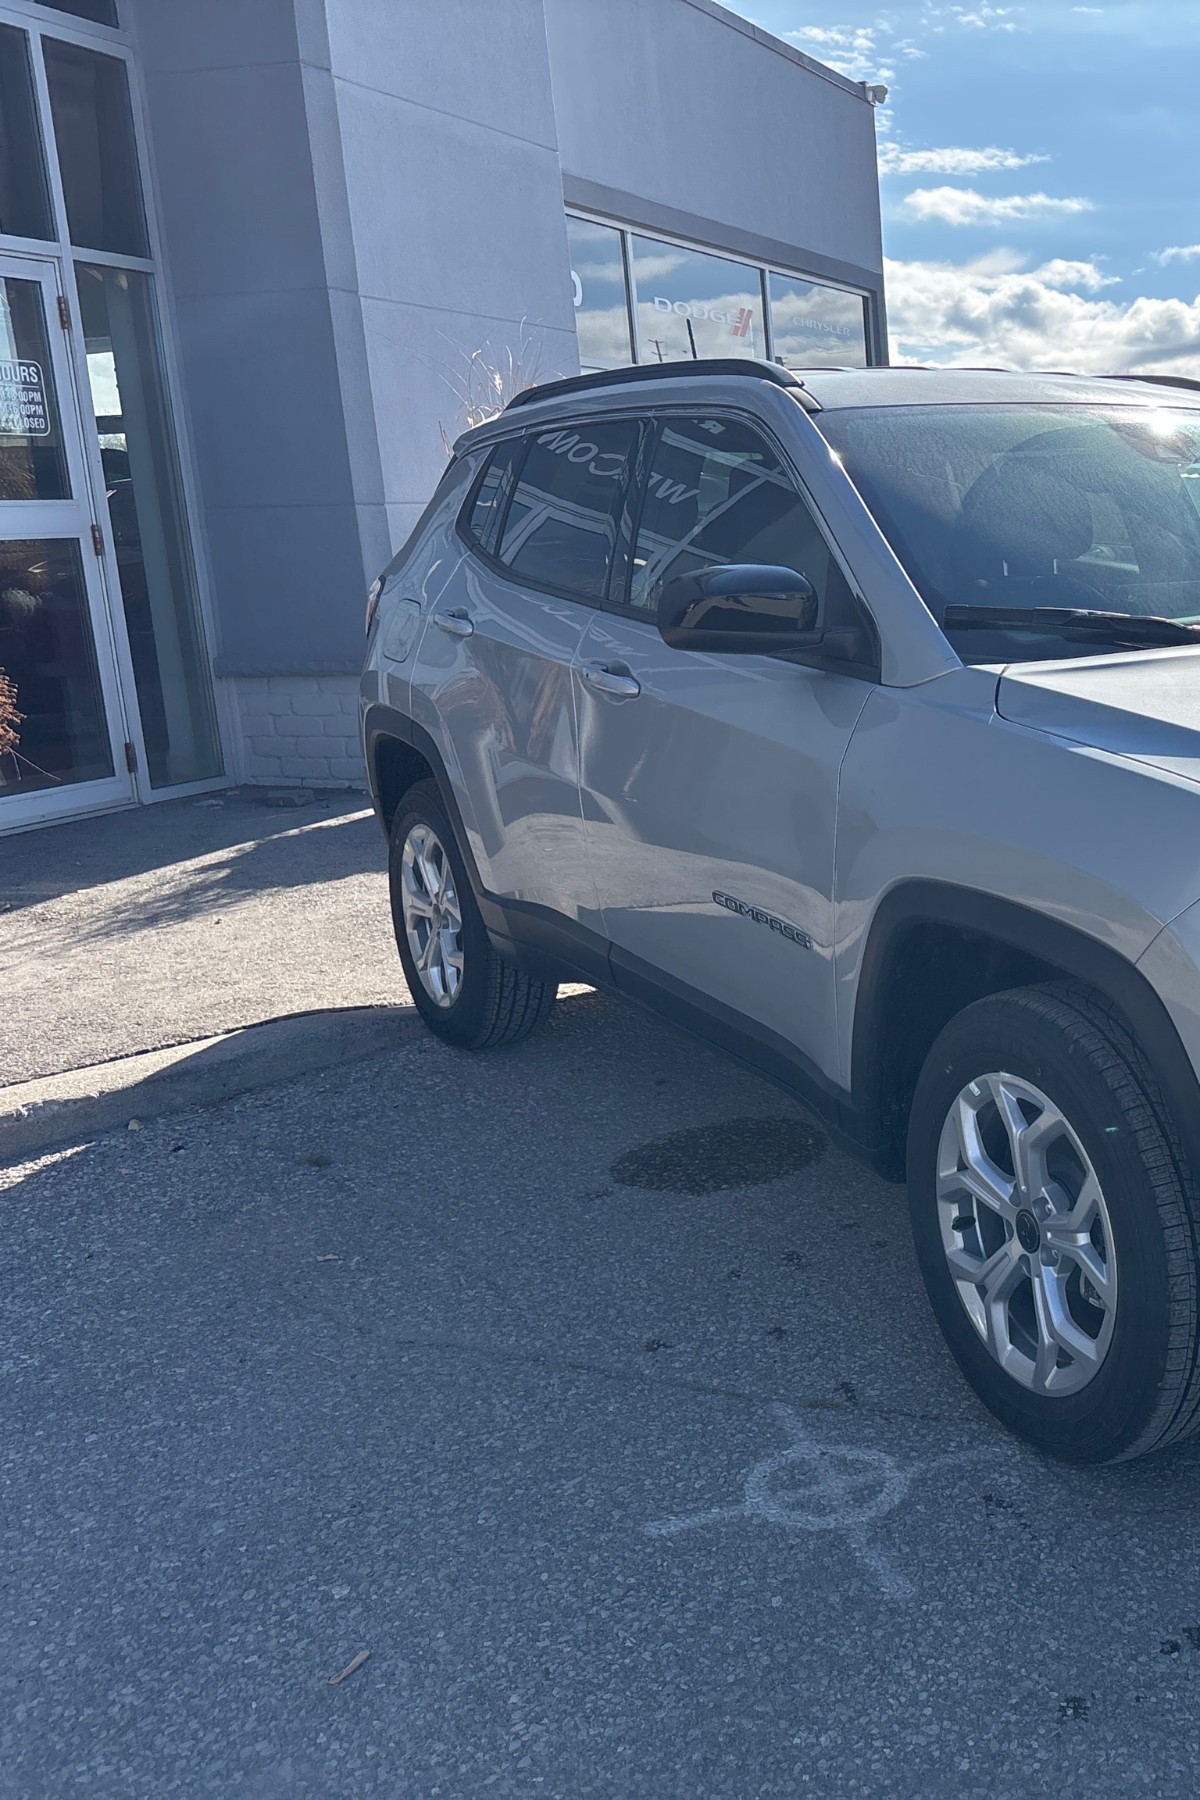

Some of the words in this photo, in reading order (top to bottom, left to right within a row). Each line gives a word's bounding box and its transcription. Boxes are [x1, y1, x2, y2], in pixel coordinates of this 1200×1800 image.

[653, 297, 743, 327] DODGE
[792, 316, 851, 337] CHRYSLER
[0, 366, 39, 383] OURS
[712, 890, 812, 949] COMPASS
